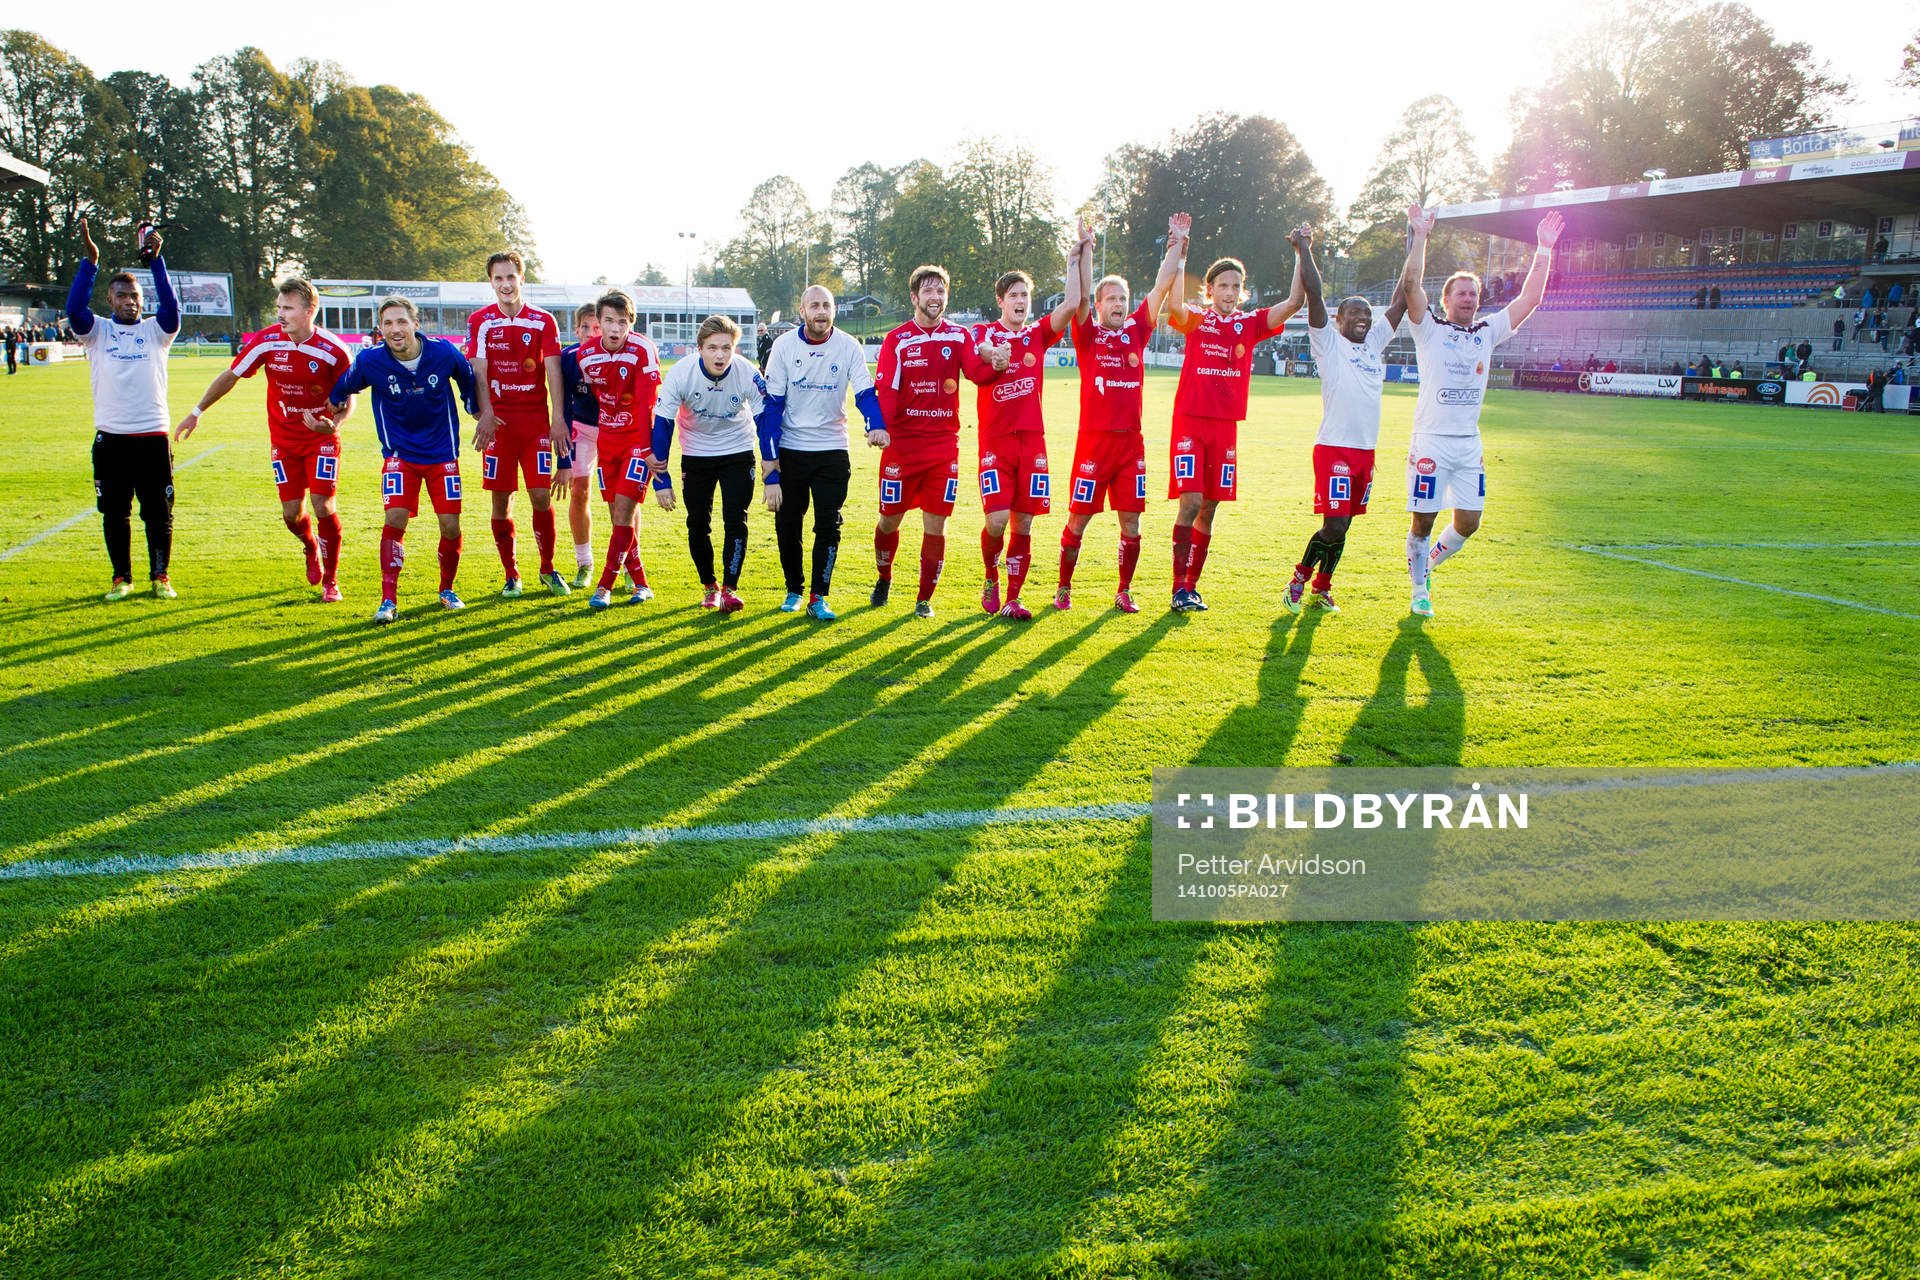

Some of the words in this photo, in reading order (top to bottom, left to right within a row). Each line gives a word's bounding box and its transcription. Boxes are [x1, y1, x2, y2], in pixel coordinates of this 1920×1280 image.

[1197, 367, 1240, 377] team:olivia
[1595, 375, 1613, 385] LW
[1658, 378, 1678, 388] LW
[389, 384, 400, 395] 14
[1761, 385, 1777, 393] Ford
[1448, 390, 1480, 399] EWG
[906, 408, 953, 417] team:olivia
[1329, 501, 1339, 509] 19
